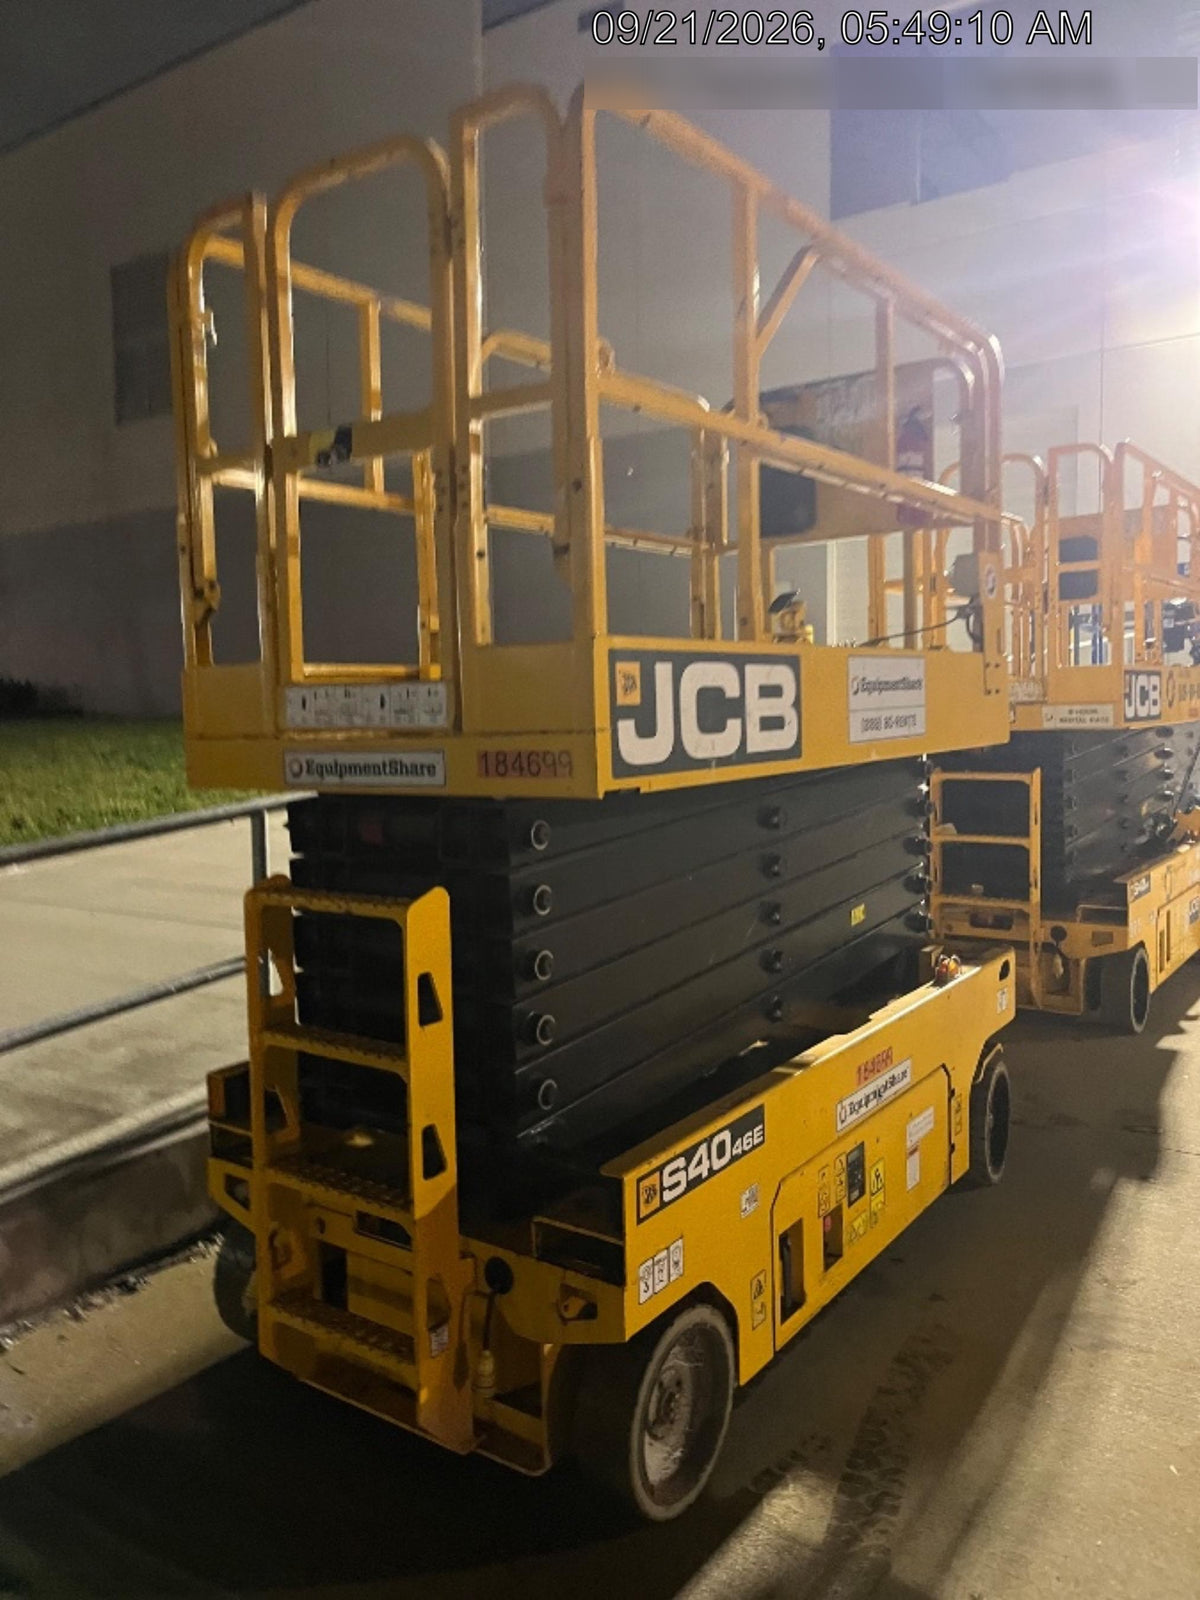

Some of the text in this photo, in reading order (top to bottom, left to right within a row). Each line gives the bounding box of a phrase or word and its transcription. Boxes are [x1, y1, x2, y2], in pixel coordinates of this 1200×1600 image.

[617, 660, 798, 766] JCB
[1125, 674, 1160, 718] JCB
[305, 758, 437, 780] EquipmentShare
[480, 749, 573, 777] 184699
